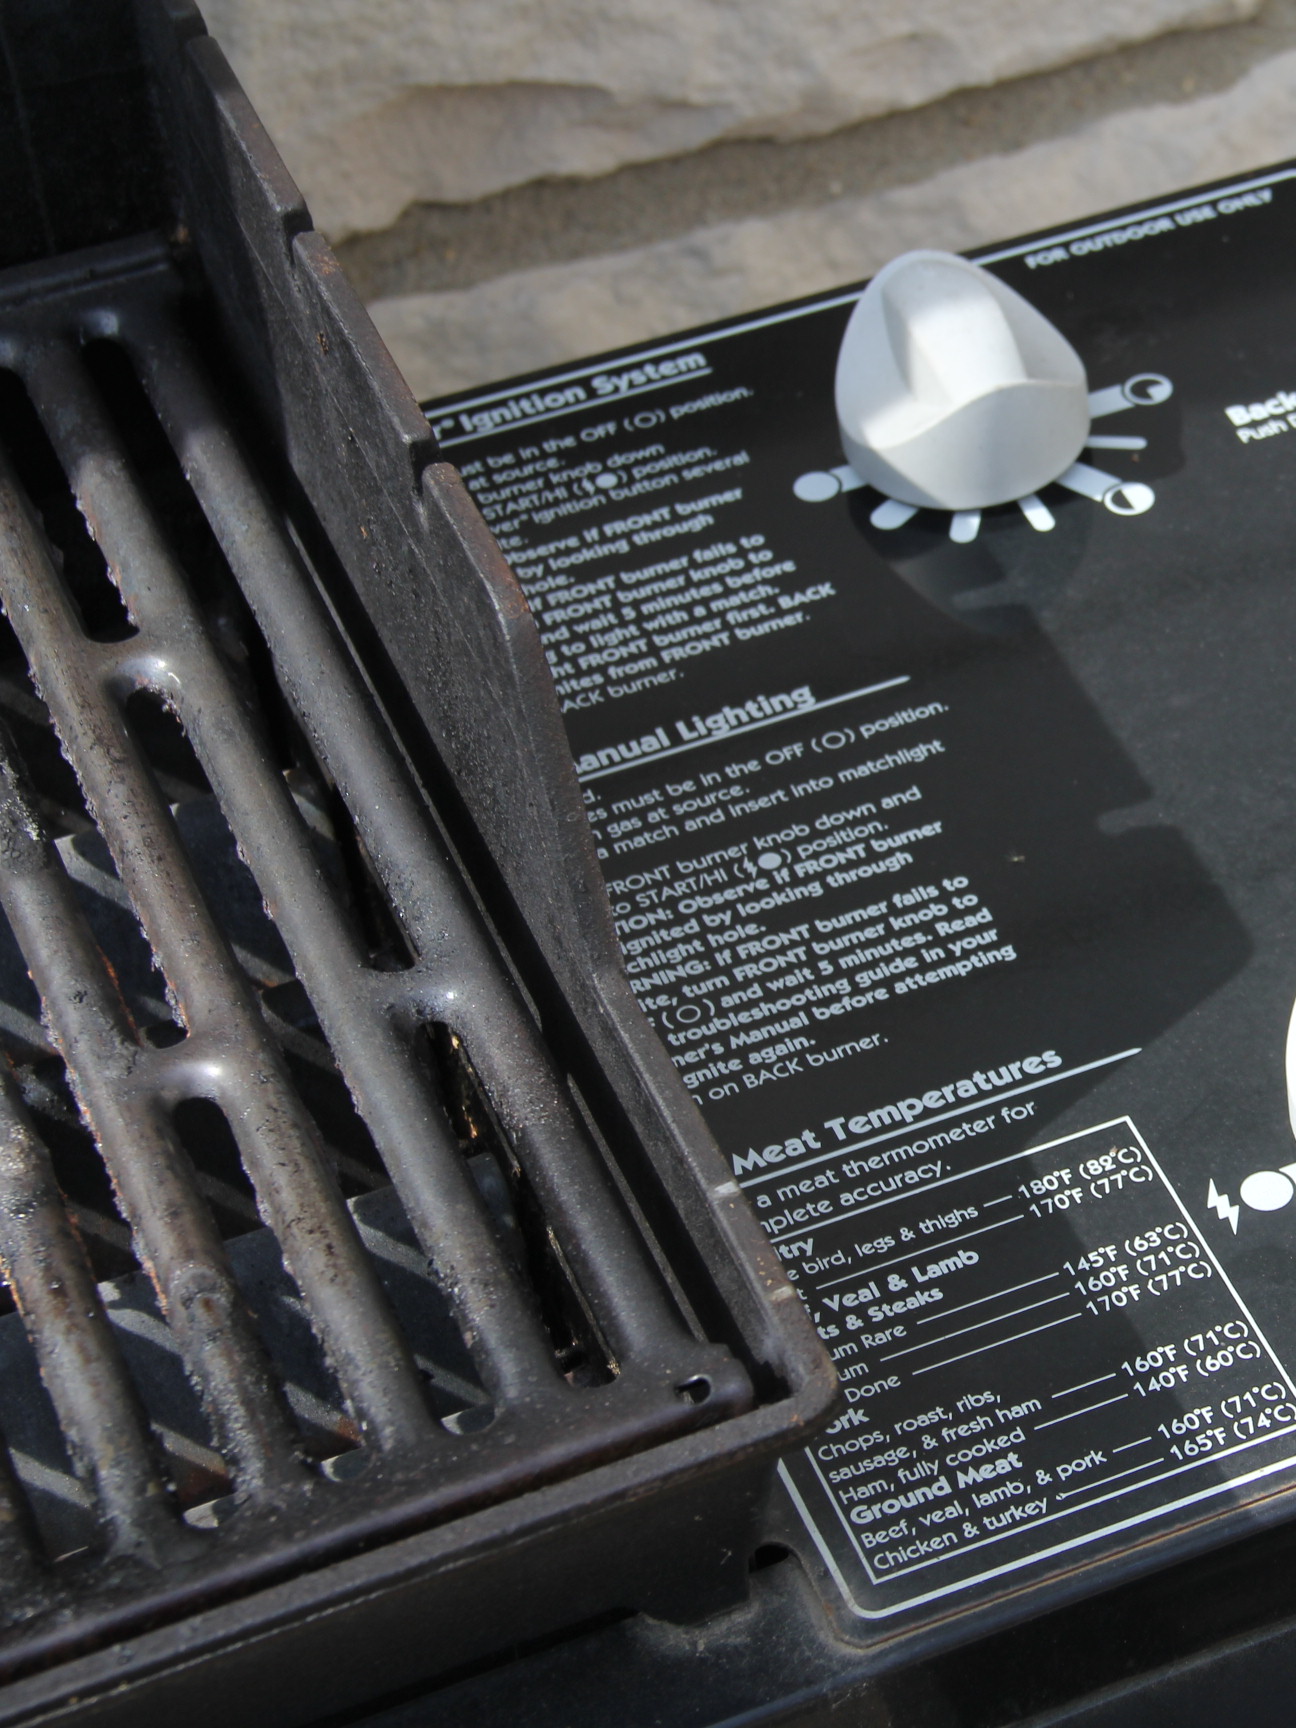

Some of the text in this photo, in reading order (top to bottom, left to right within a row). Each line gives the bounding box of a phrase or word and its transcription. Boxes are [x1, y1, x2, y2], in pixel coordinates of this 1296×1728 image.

[1024, 188, 1272, 269] FOR OUTDOOR USE ONLY
[459, 352, 707, 433] Ignition System
[1236, 419, 1288, 444] Push
[476, 444, 665, 505] burner knob down
[602, 506, 671, 537] FRONT
[674, 488, 742, 516] burner
[572, 560, 796, 634] wait 5 minutes before
[577, 582, 836, 670] FRONT burner first. BACK
[589, 584, 780, 648] light with a match.
[675, 685, 816, 741] Lighting
[611, 702, 949, 815] must be in the OFF position.
[613, 739, 946, 854] match and insert into matchlight
[675, 785, 922, 874] burner knob down and
[677, 878, 770, 914] Observe
[793, 843, 867, 878] FRONT
[870, 821, 942, 852] burner
[720, 907, 993, 1008] and wait 5 minutes. Read
[735, 923, 810, 960] FRONT
[814, 901, 888, 933] burner
[892, 885, 940, 909] fails
[942, 876, 969, 892] to
[667, 928, 998, 1046] troubleshooting guide in your
[729, 944, 1017, 1050] Manual before attempting
[732, 1050, 1063, 1176] Meat Temperatures
[756, 1101, 1035, 1208] a meat thermometer for
[839, 1160, 951, 1206] accuracy.
[801, 1249, 852, 1275] bird,
[854, 1235, 896, 1257] legs
[899, 1227, 916, 1242] &
[918, 1206, 979, 1234] thighs
[822, 1249, 980, 1312] Veal & Lamb
[845, 1287, 944, 1330] & Steaks
[860, 1325, 907, 1349] Rare
[818, 1390, 1001, 1461] Chops, roast, ribs,
[843, 1375, 901, 1403] Done
[828, 1446, 917, 1483] sausage,
[921, 1434, 939, 1450] &
[941, 1415, 994, 1443] fresh
[995, 1399, 1042, 1423] ham
[838, 1479, 895, 1505] Ham,
[897, 1459, 939, 1484] fully
[945, 1426, 1026, 1466] cooked
[849, 1451, 1023, 1525] Ground Meat
[860, 1518, 916, 1549] Beef,
[918, 1499, 970, 1526] veal,
[971, 1481, 1031, 1509] lamb,
[1035, 1469, 1053, 1486] &
[1056, 1450, 1108, 1481] pork
[873, 1532, 958, 1569] Chicken
[962, 1522, 980, 1539] &
[982, 1497, 1047, 1530] turkey
